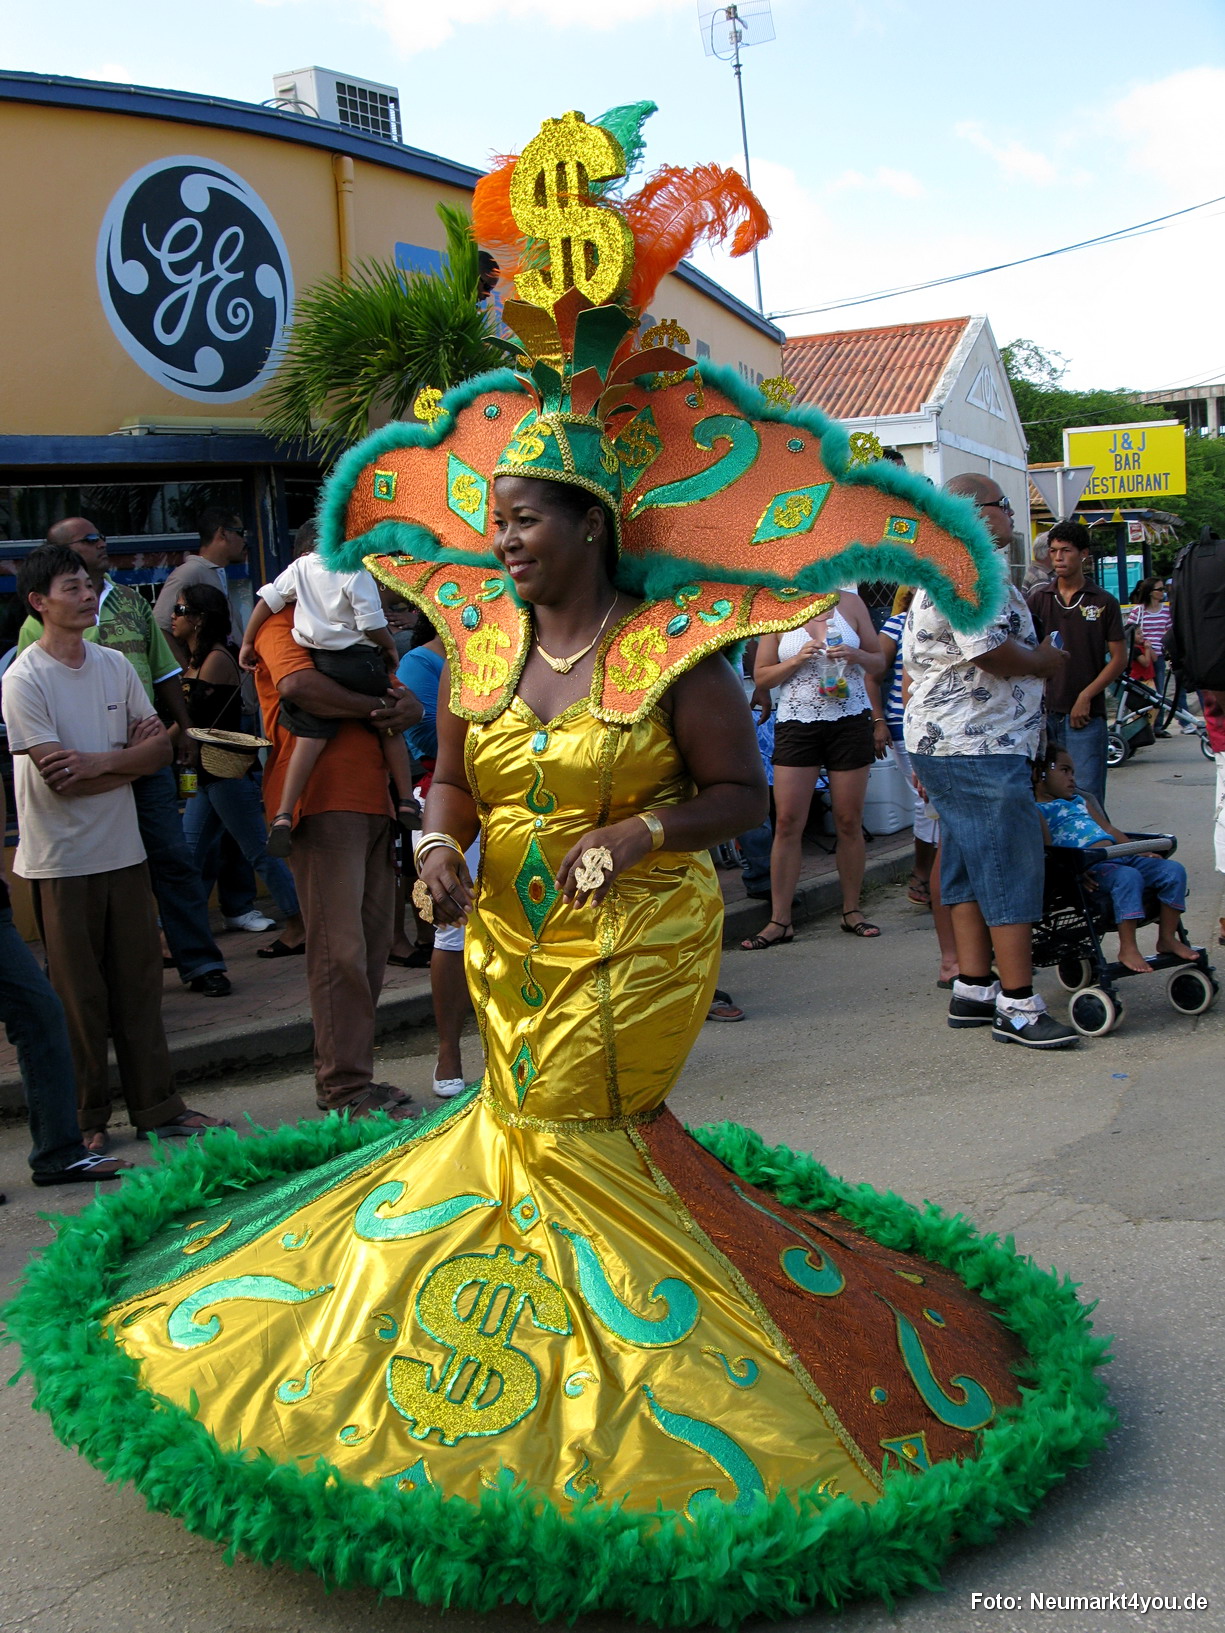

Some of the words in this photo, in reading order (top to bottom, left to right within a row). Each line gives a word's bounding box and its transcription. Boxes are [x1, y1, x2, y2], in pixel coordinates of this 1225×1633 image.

[142, 216, 254, 345] GE
[1109, 434, 1117, 453] J
[1121, 433, 1134, 450] &
[1138, 432, 1145, 451] J
[1115, 453, 1141, 471] BAR
